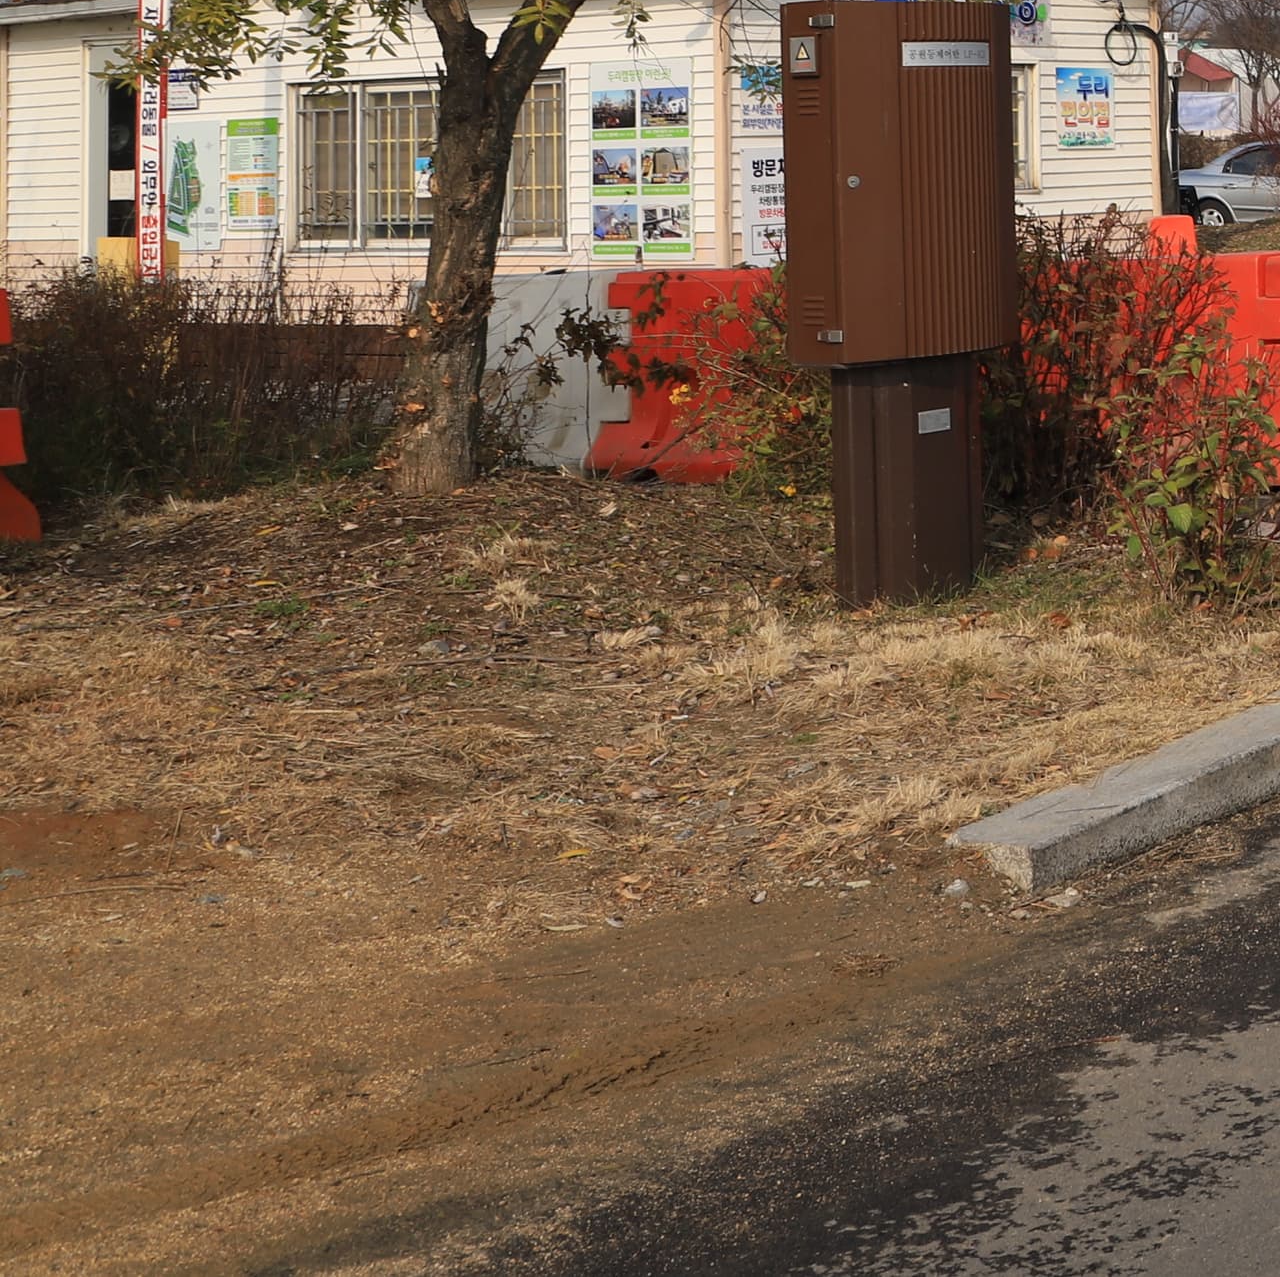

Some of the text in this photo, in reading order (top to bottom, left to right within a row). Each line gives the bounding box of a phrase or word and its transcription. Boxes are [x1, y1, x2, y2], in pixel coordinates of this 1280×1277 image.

[1077, 75, 1109, 101] 두리
[1060, 101, 1110, 128] 편의점
[141, 160, 158, 207] 외부인
[141, 215, 159, 277] 출입금지
